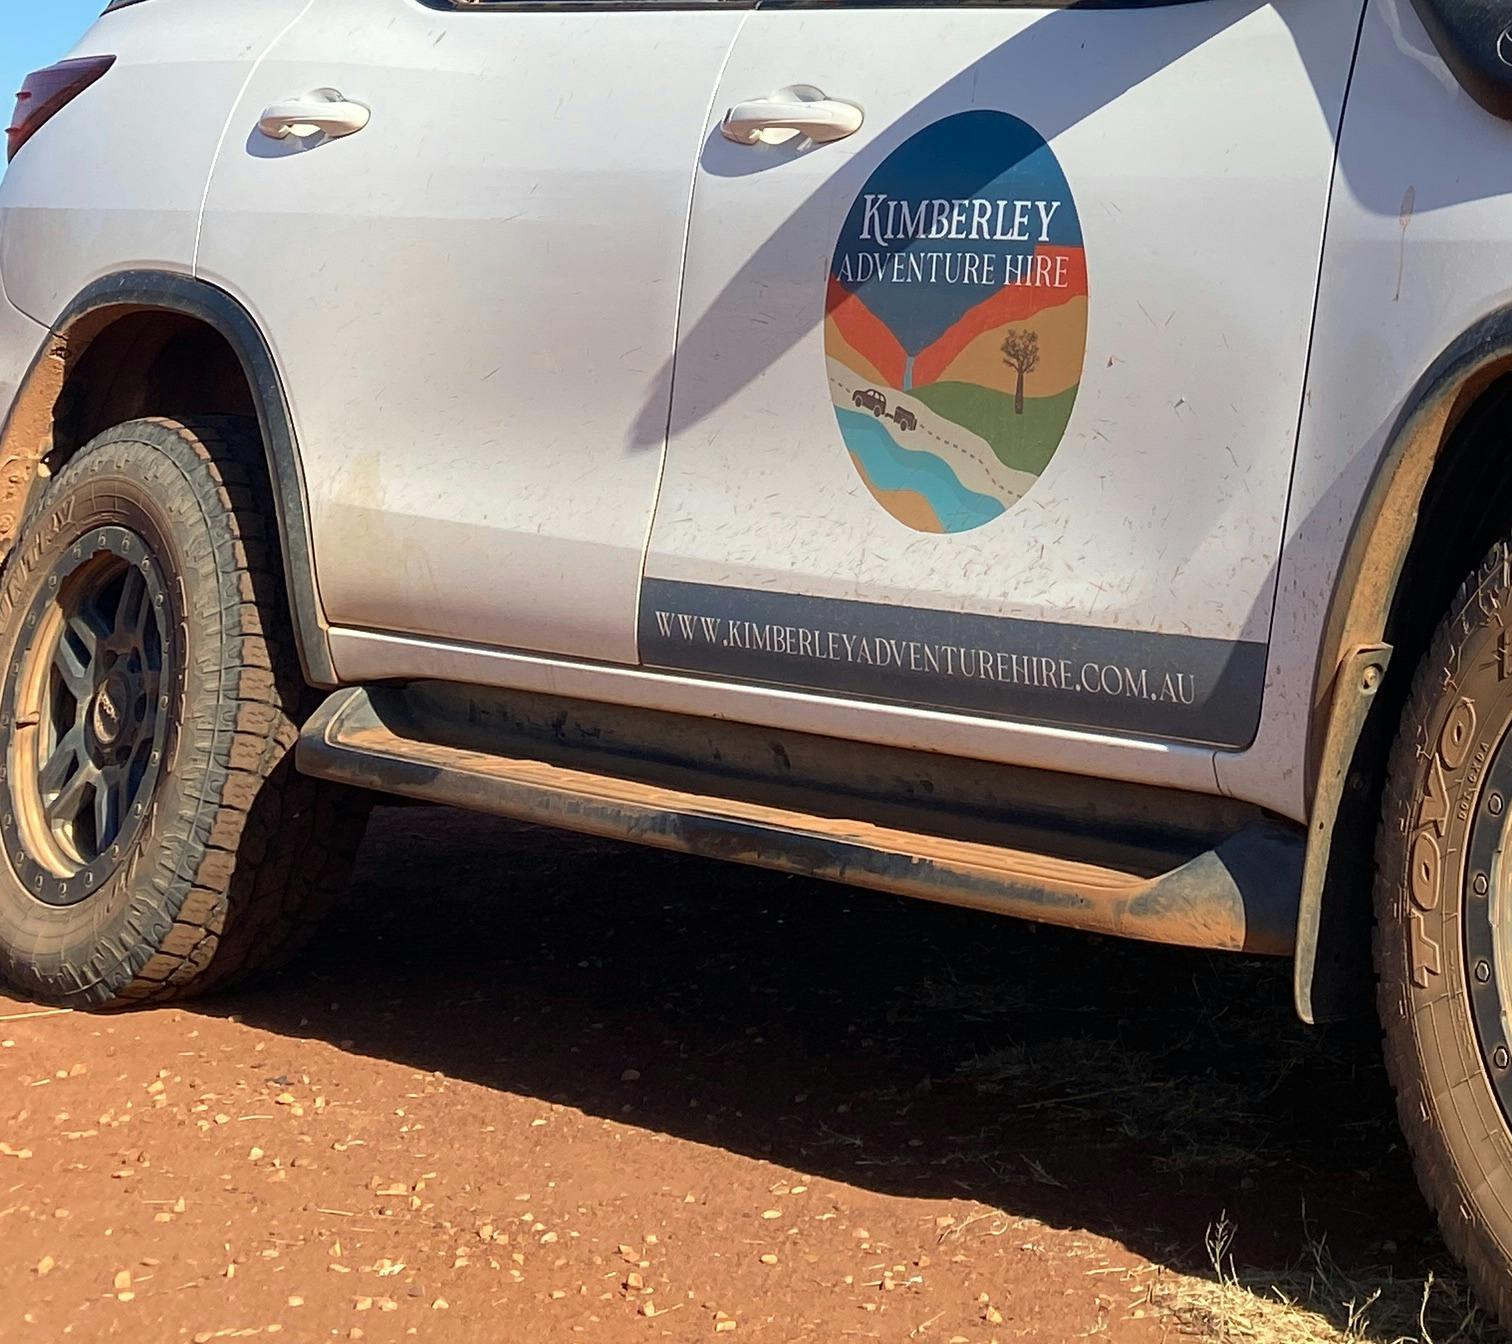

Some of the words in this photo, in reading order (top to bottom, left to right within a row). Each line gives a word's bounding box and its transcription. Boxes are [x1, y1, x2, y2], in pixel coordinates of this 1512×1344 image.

[859, 194, 1061, 247] KIMBERLEY
[836, 251, 995, 285] ADVENTURE
[1003, 254, 1070, 288] HIRE
[654, 610, 1196, 706] WWW.KIMBERLEYADVENTUREHIRE.COM.AU
